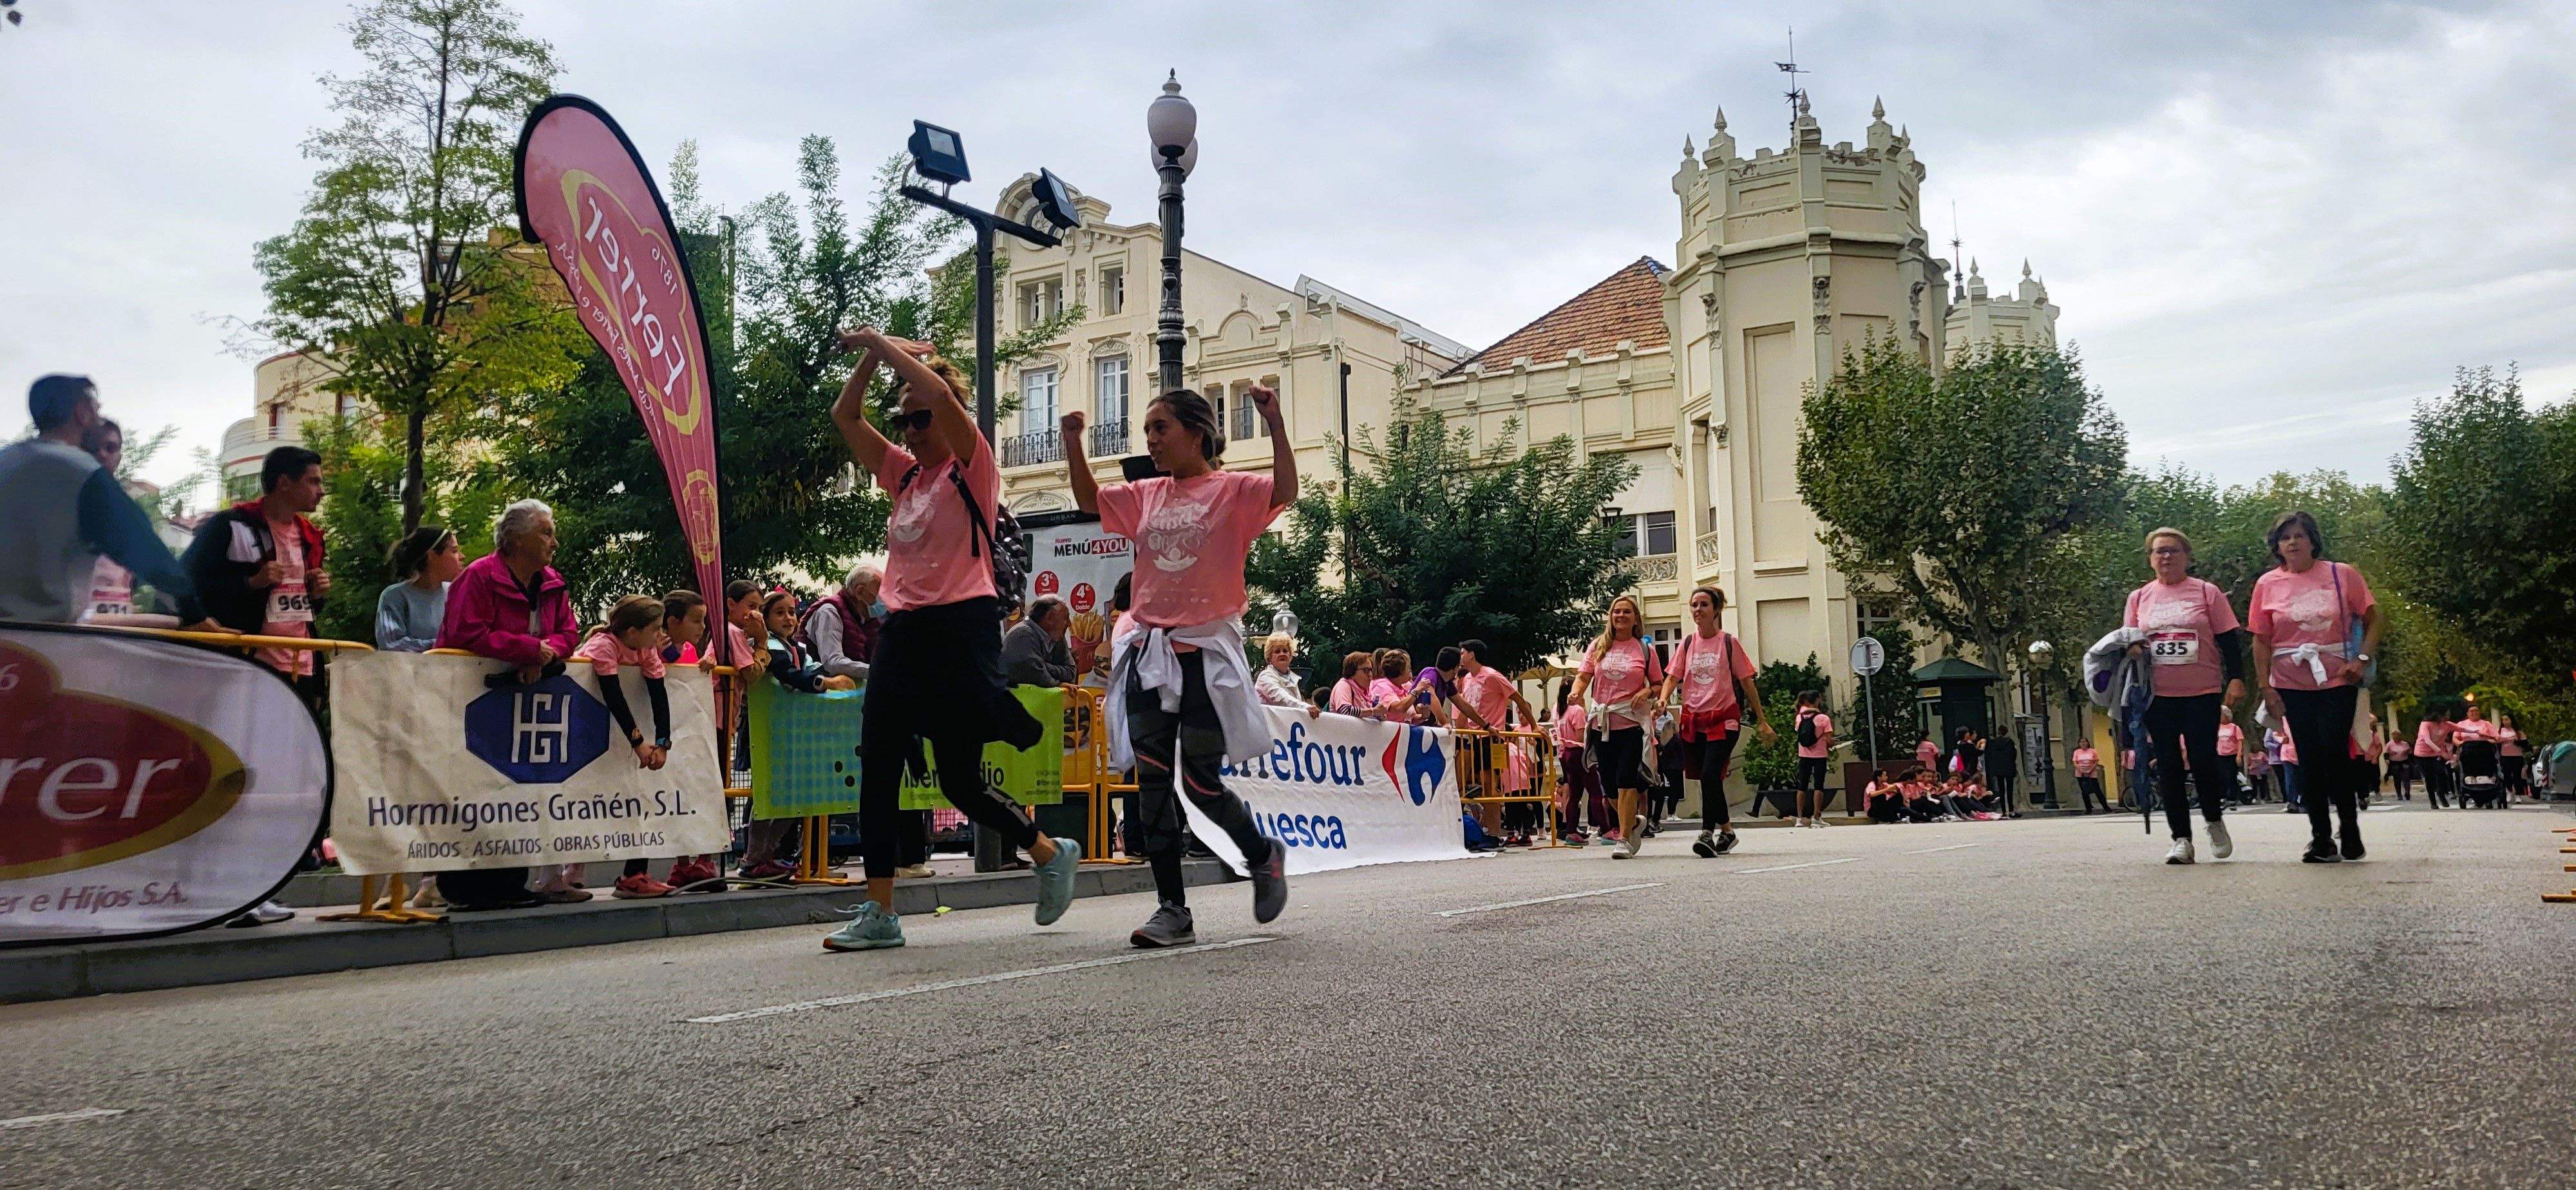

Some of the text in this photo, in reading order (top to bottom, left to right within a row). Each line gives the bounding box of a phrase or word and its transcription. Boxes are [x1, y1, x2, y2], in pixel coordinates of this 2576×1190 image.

[1054, 538, 1091, 558] MENÚ
[1092, 538, 1129, 554] 4YOU
[2155, 641, 2188, 656] 835
[1219, 721, 1366, 786] efour
[368, 789, 697, 832] Hormigones Grañén, S.L.
[1244, 800, 1347, 849] uesca
[407, 831, 665, 859] ÁRIDOS ASFALTOS OBRAS PÚBLICAS
[30, 893, 52, 912] e
[57, 884, 135, 914] Hijos
